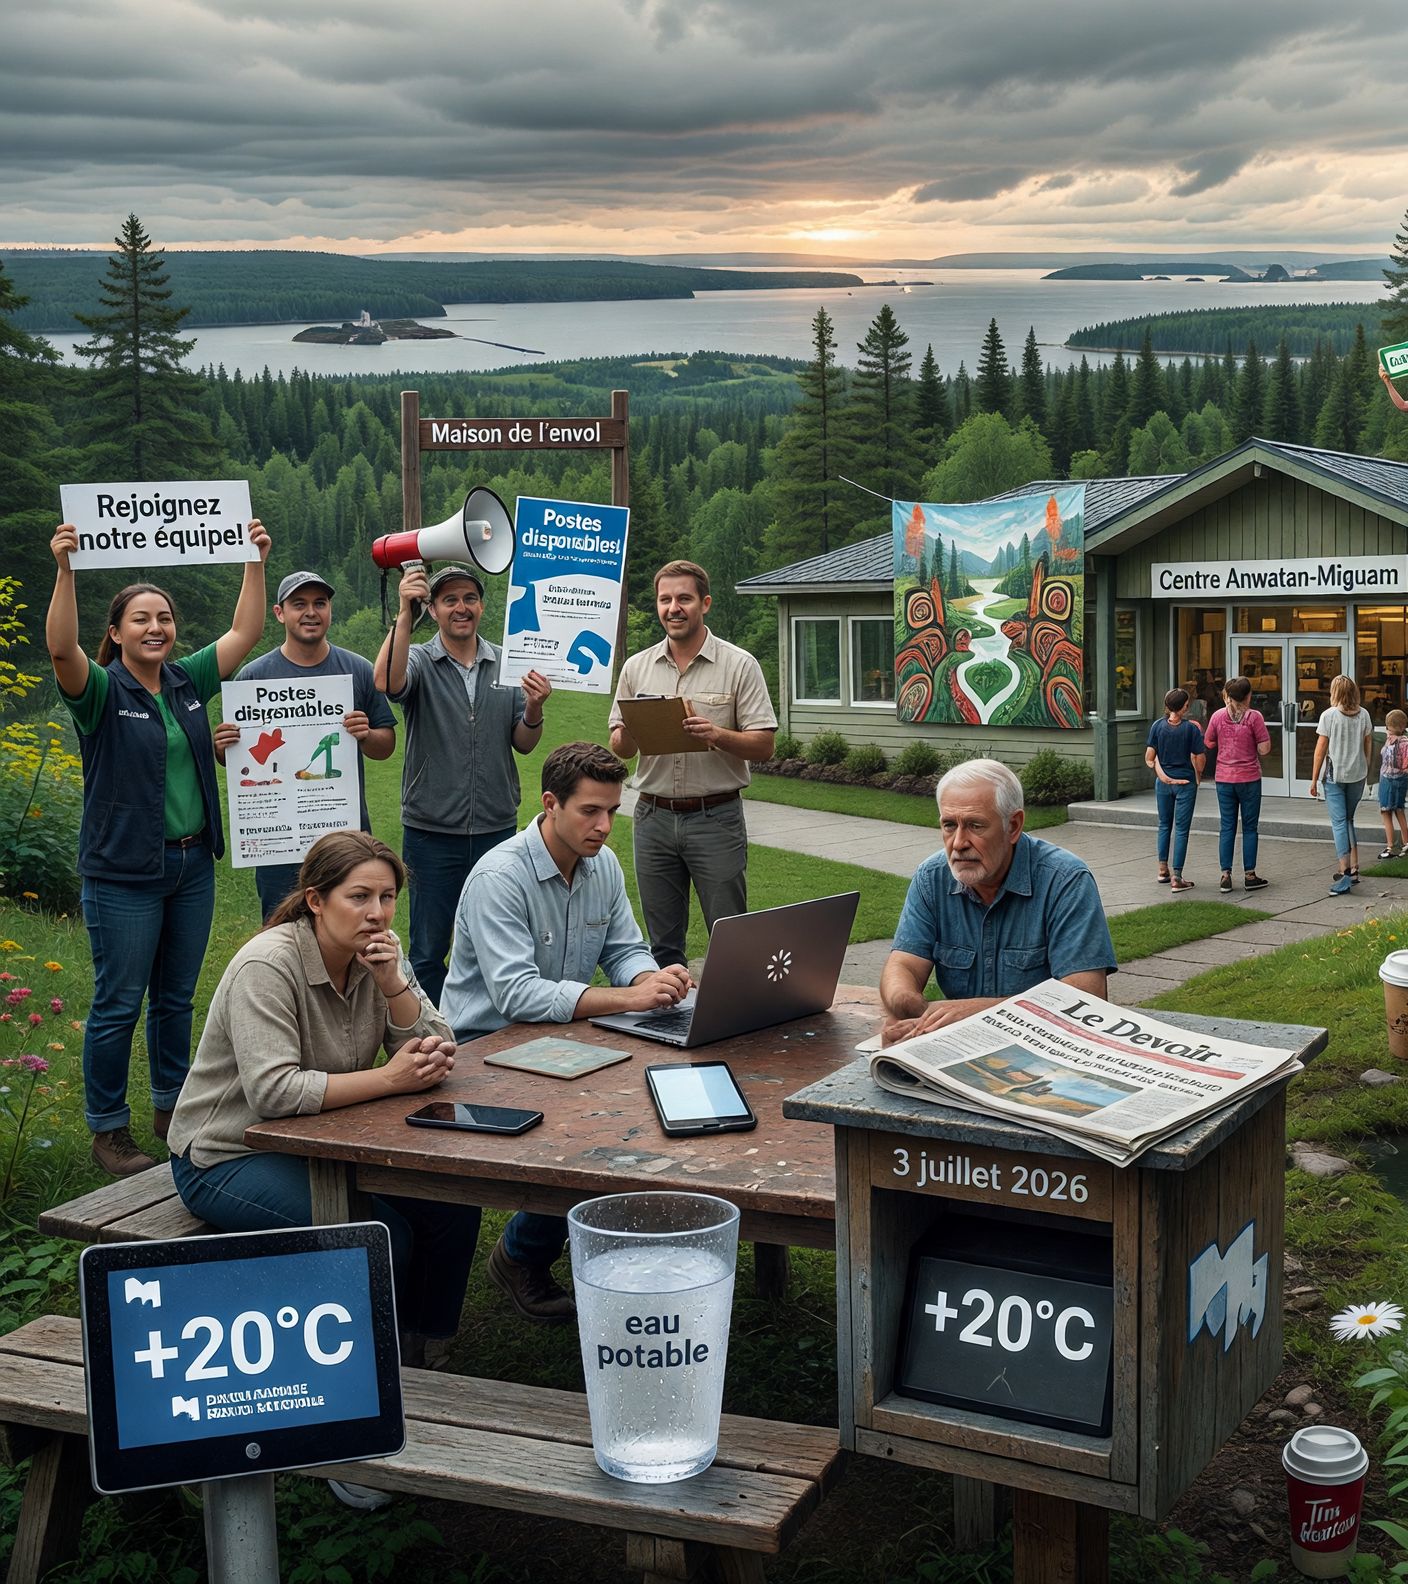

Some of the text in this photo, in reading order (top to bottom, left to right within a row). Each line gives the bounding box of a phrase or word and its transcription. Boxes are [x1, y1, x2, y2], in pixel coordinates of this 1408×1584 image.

[431, 421, 600, 444] Maison de l'envol
[97, 492, 221, 524] Rejoignez
[543, 508, 602, 532] Postes
[79, 523, 244, 554] notre équipe!
[1159, 563, 1399, 592] Centre Anwatan-Miguam
[256, 686, 316, 703] Postes
[1060, 999, 1104, 1028] Le
[892, 1148, 1089, 1203] 3 juillet 2026
[625, 1314, 680, 1335] eau
[925, 1288, 1096, 1361] +20°C
[134, 1302, 354, 1382] +20°C
[597, 1338, 709, 1370] potable
